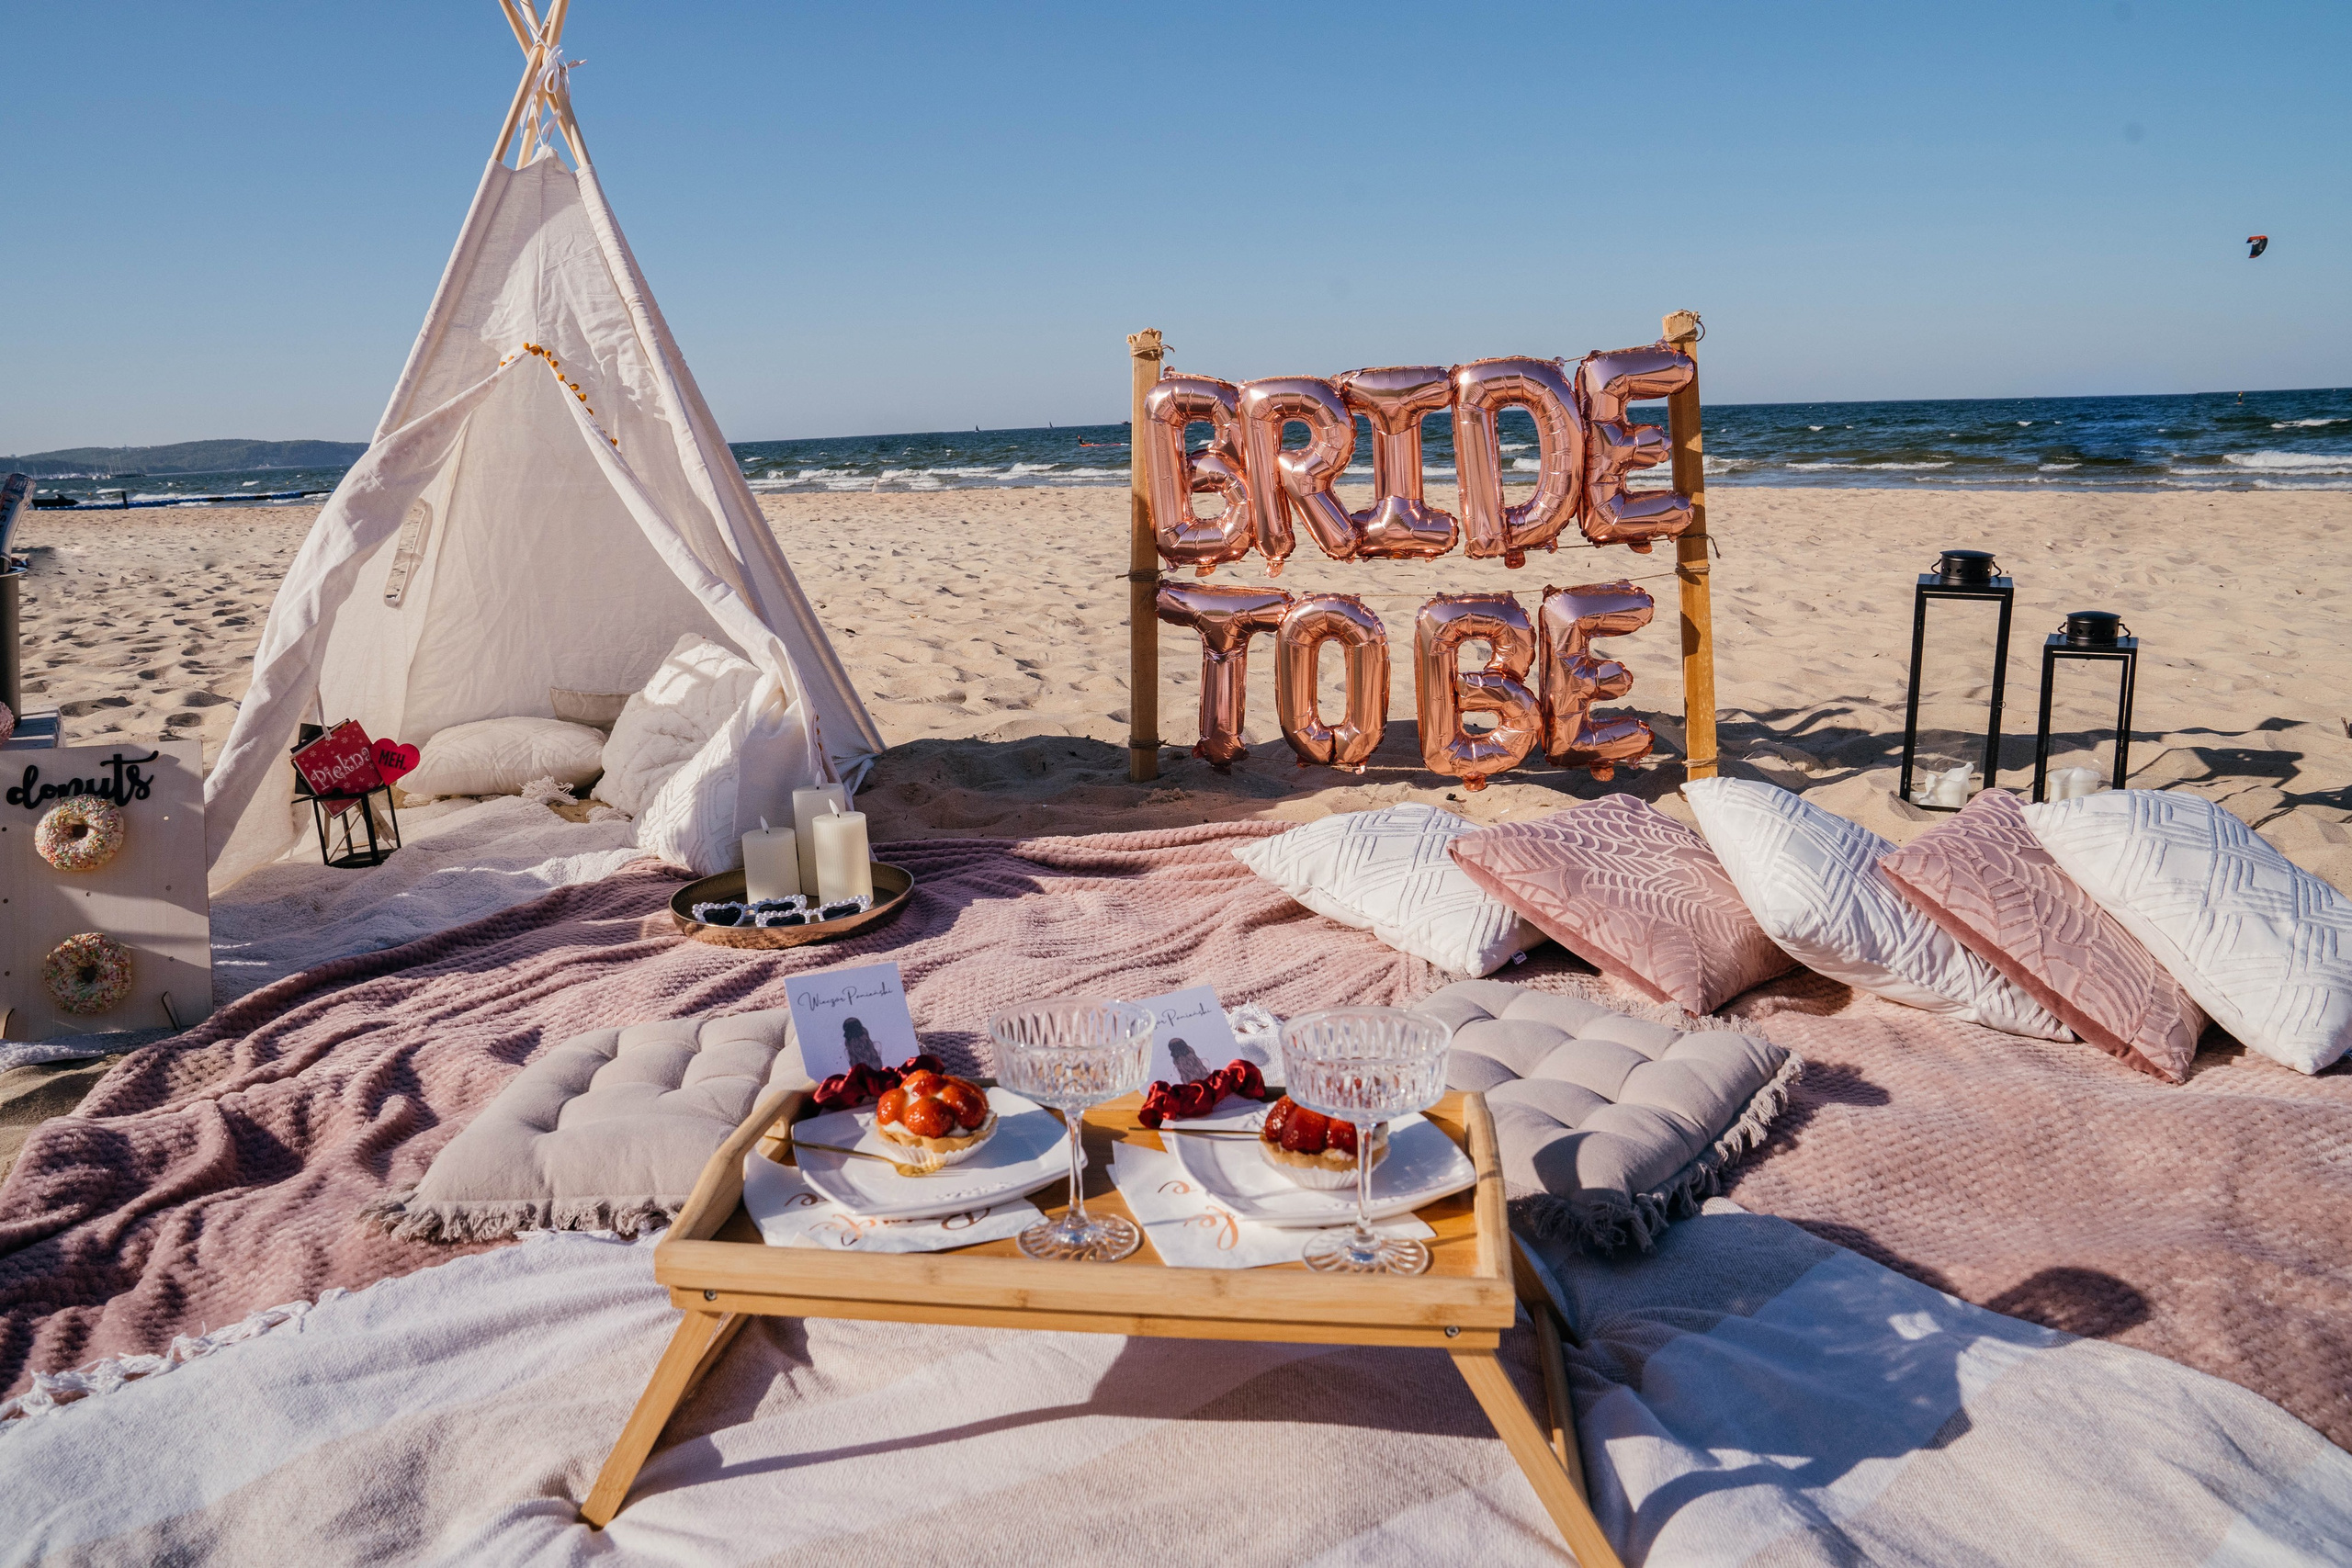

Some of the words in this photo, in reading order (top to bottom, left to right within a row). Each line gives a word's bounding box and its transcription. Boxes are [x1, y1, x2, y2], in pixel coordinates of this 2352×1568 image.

[1144, 340, 1695, 573] BRIDE
[1155, 579, 1390, 773] TO
[1415, 579, 1655, 783] BE
[6, 750, 159, 809] donuts
[378, 750, 406, 771] MEH.
